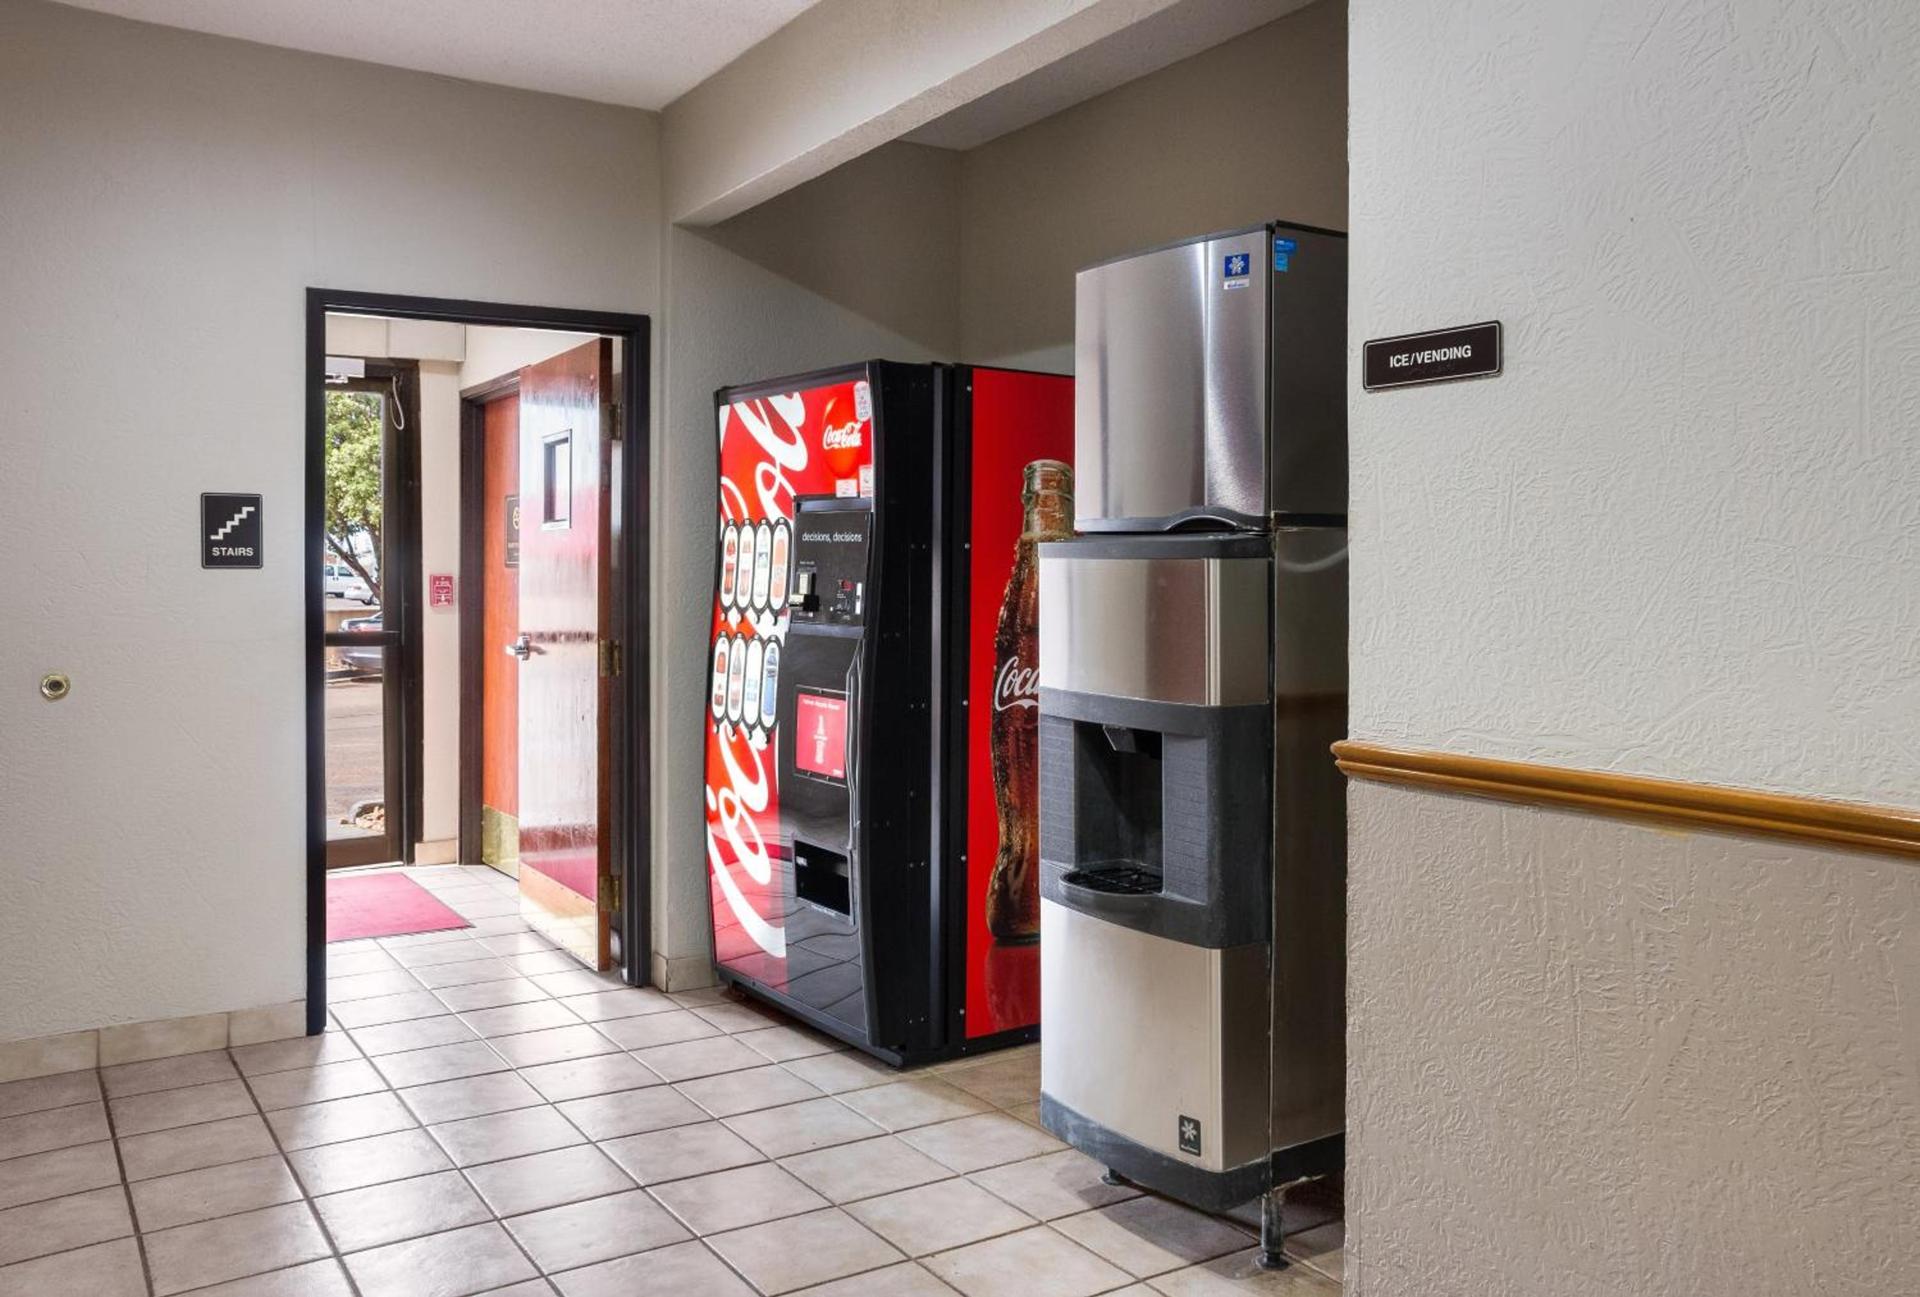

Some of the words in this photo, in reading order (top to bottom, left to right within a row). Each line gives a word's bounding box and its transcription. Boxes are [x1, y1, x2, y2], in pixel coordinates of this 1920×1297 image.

[1389, 345, 1472, 368] ICE/VENDING
[801, 532, 832, 543] decisions,
[832, 532, 862, 543] decisions
[212, 547, 254, 557] STAIRS
